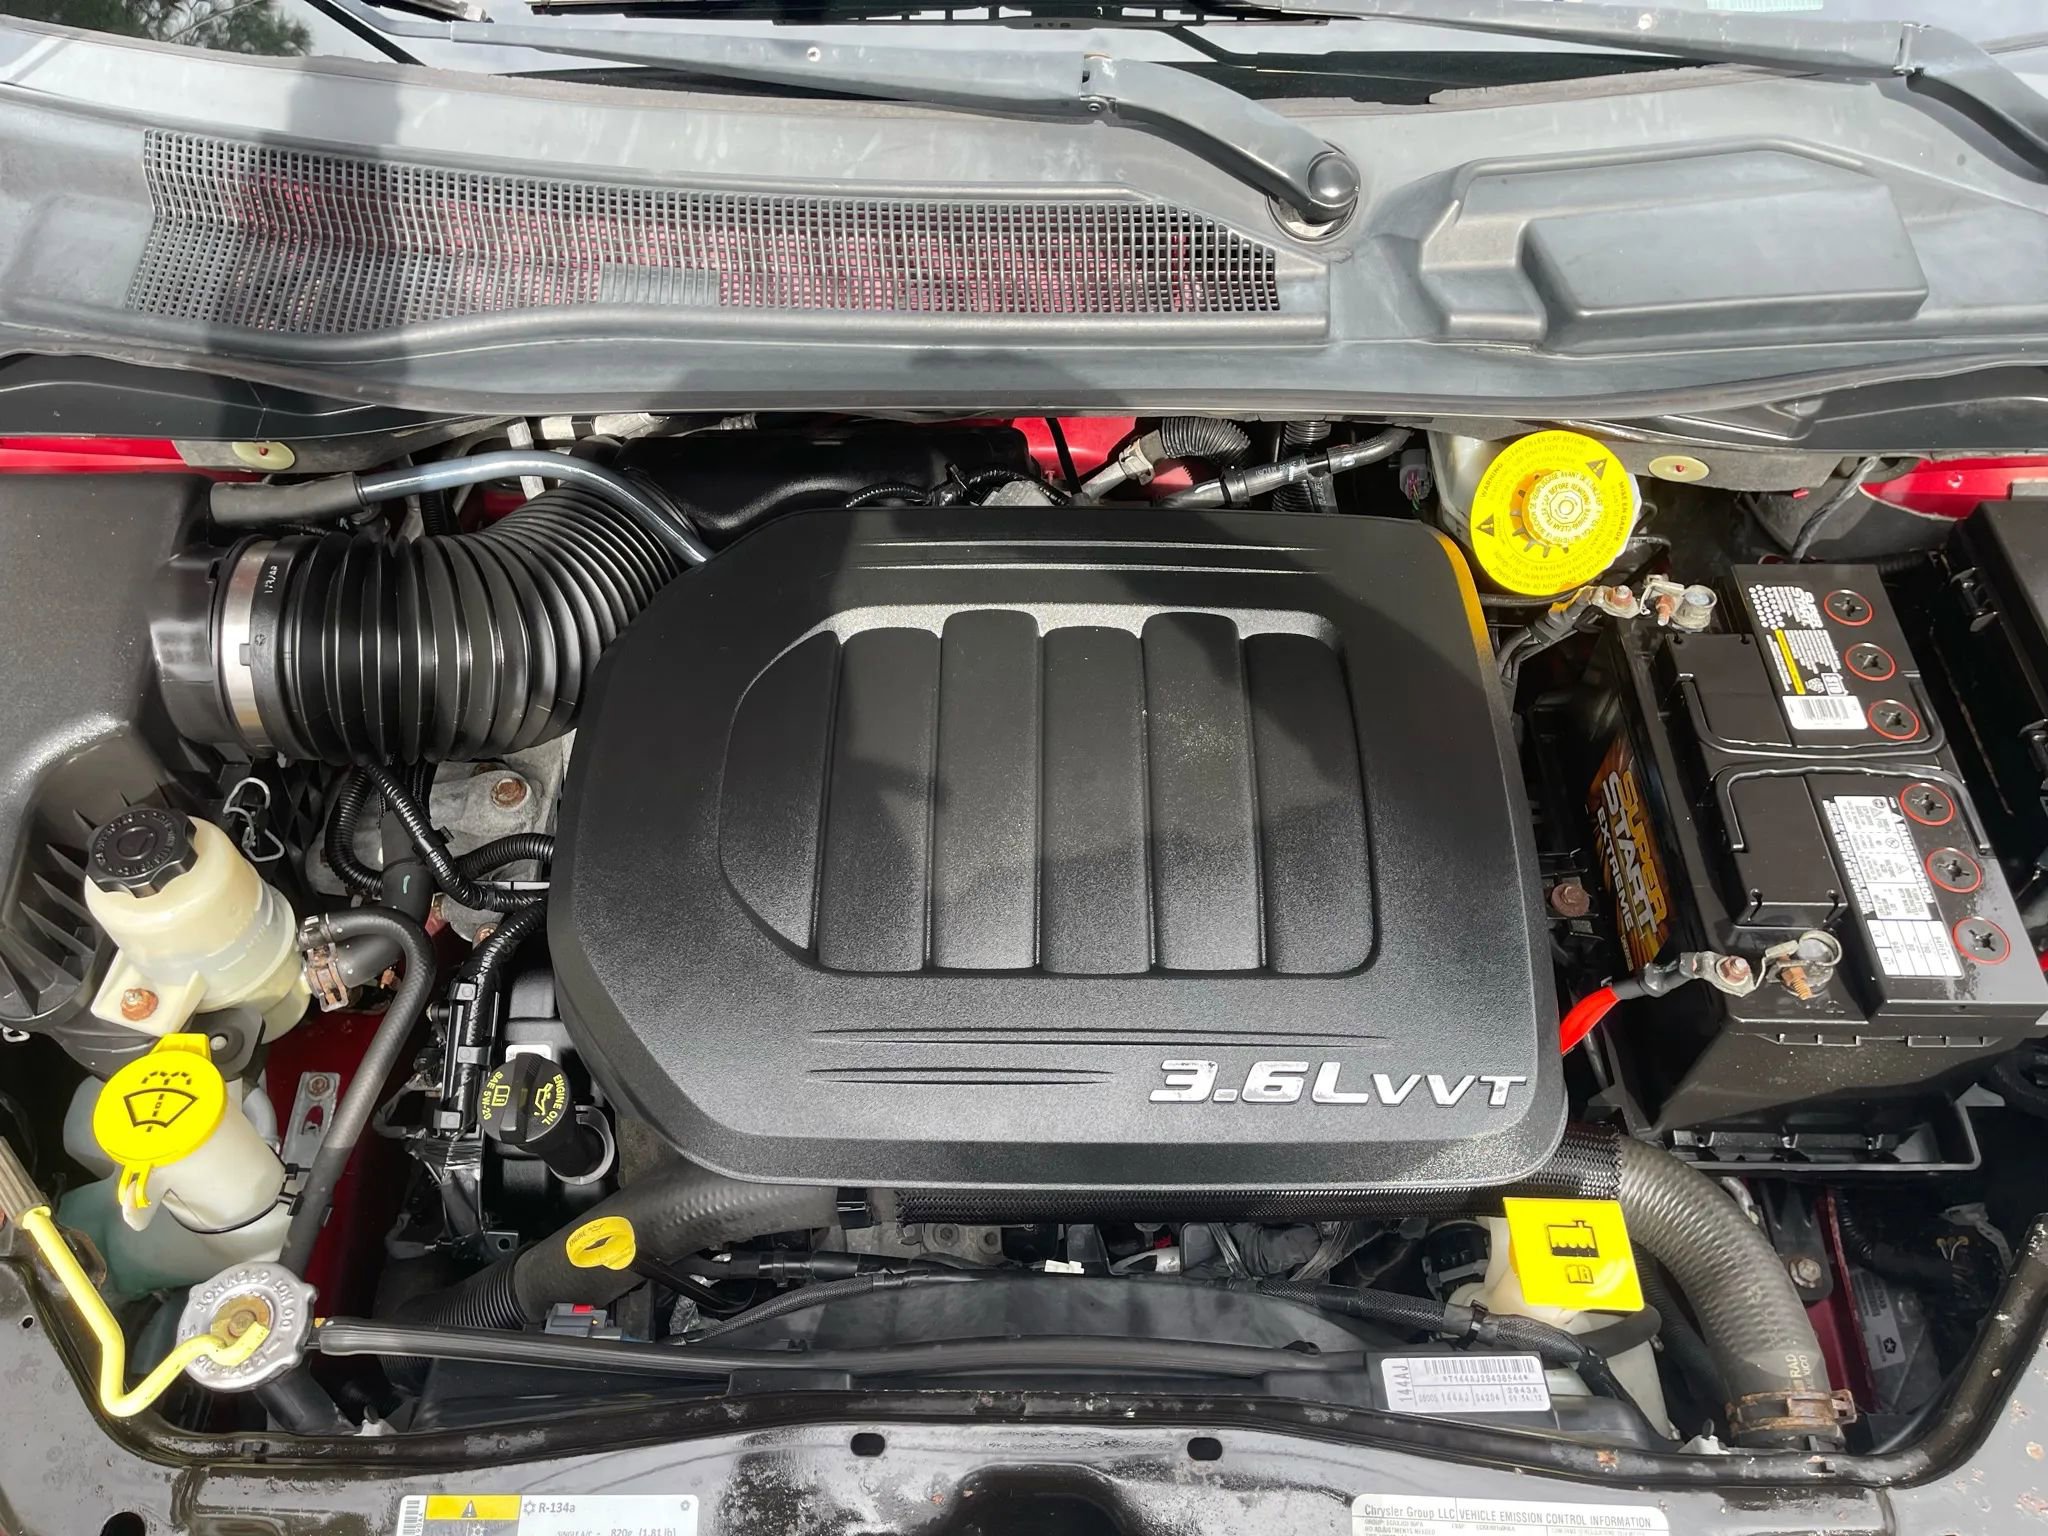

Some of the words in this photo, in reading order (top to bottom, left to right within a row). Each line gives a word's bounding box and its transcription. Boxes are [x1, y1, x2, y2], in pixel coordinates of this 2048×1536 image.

[1602, 771, 1658, 934] START
[1621, 770, 1668, 926] SUPER
[1597, 806, 1634, 932] EXTREME
[487, 1071, 504, 1089] SAE
[553, 1074, 565, 1110] ENGINE
[1148, 1060, 1369, 1106] 3.6L
[1371, 1074, 1528, 1108] VVT
[482, 1090, 492, 1120] 5W-20
[542, 1110, 558, 1125] OIL
[1785, 1354, 1802, 1378] RAD
[1392, 1365, 1412, 1402] 144AJ
[538, 1502, 576, 1513] R-134a
[1365, 1504, 1403, 1517] Chrysler
[1406, 1506, 1434, 1520] Group
[1438, 1508, 1455, 1519] LLC
[1458, 1508, 1496, 1521] VEHICLE
[1500, 1511, 1542, 1523] EMISSION
[1546, 1513, 1586, 1525] CONTROL
[1591, 1516, 1651, 1528] INFORMATION
